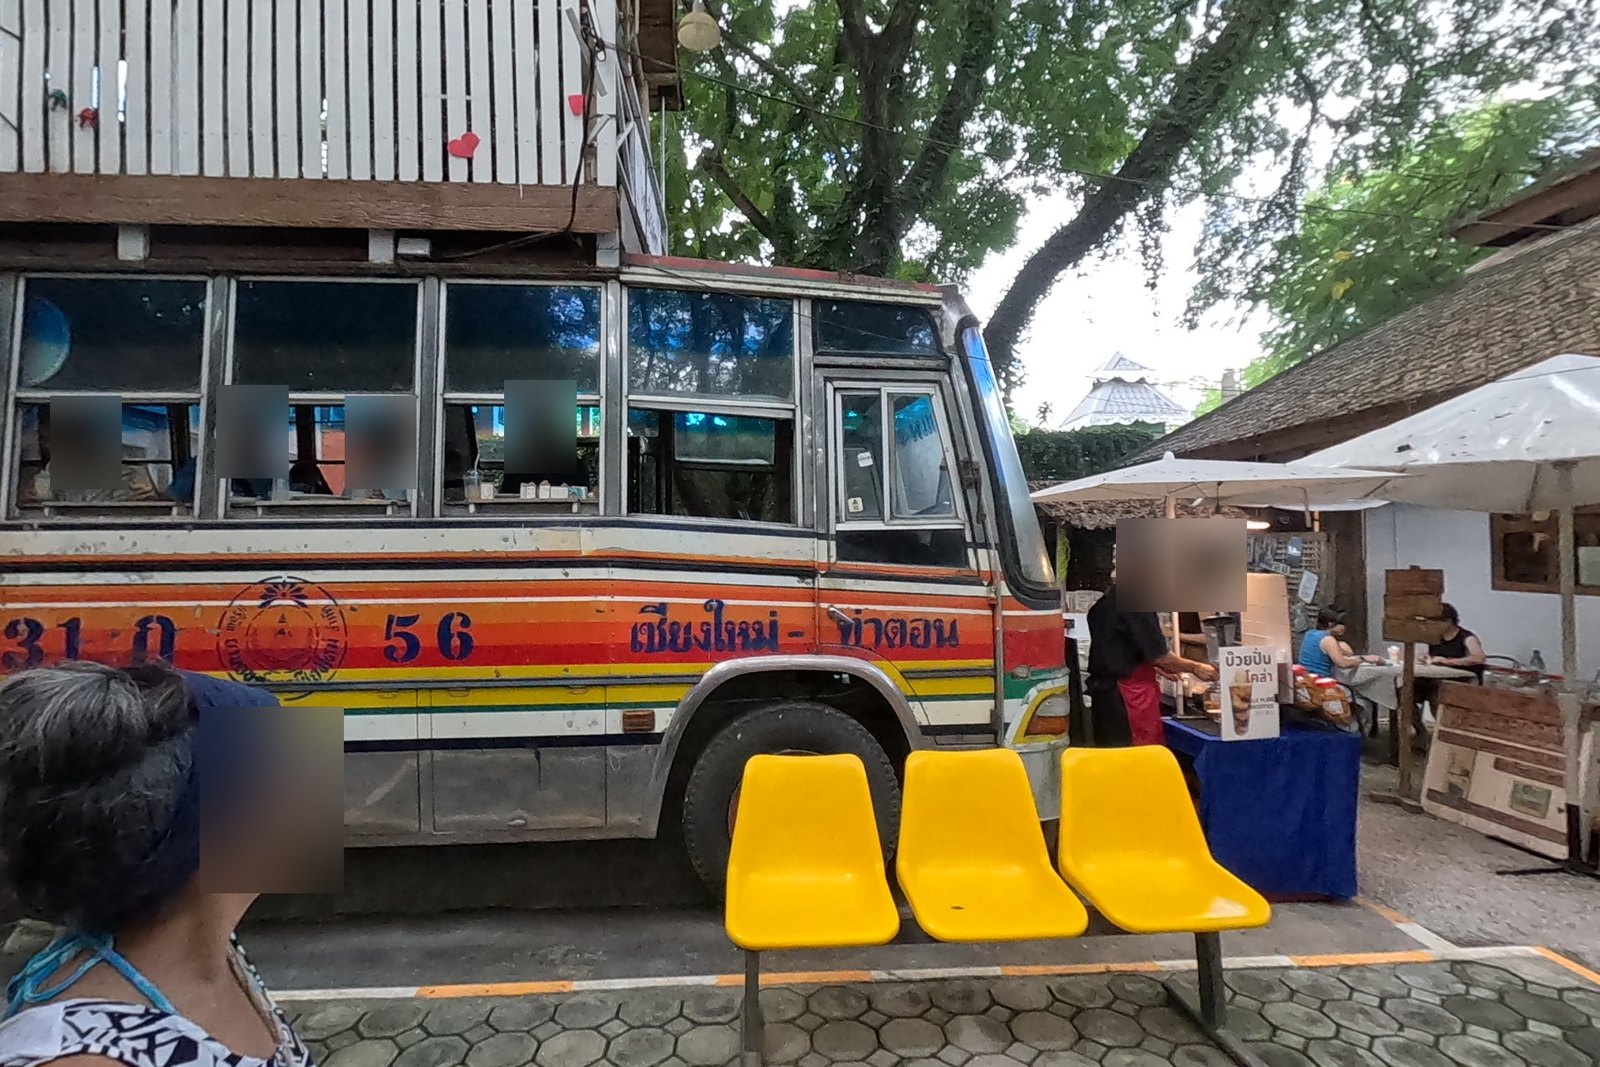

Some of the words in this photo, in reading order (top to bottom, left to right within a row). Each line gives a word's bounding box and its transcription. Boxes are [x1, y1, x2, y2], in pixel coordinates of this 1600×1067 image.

[630, 599, 779, 652] เชียงใหม่
[837, 608, 960, 649] ท่าตอน
[1225, 647, 1272, 666] บ๊วยปั่น
[1245, 669, 1273, 683] โคล่า
